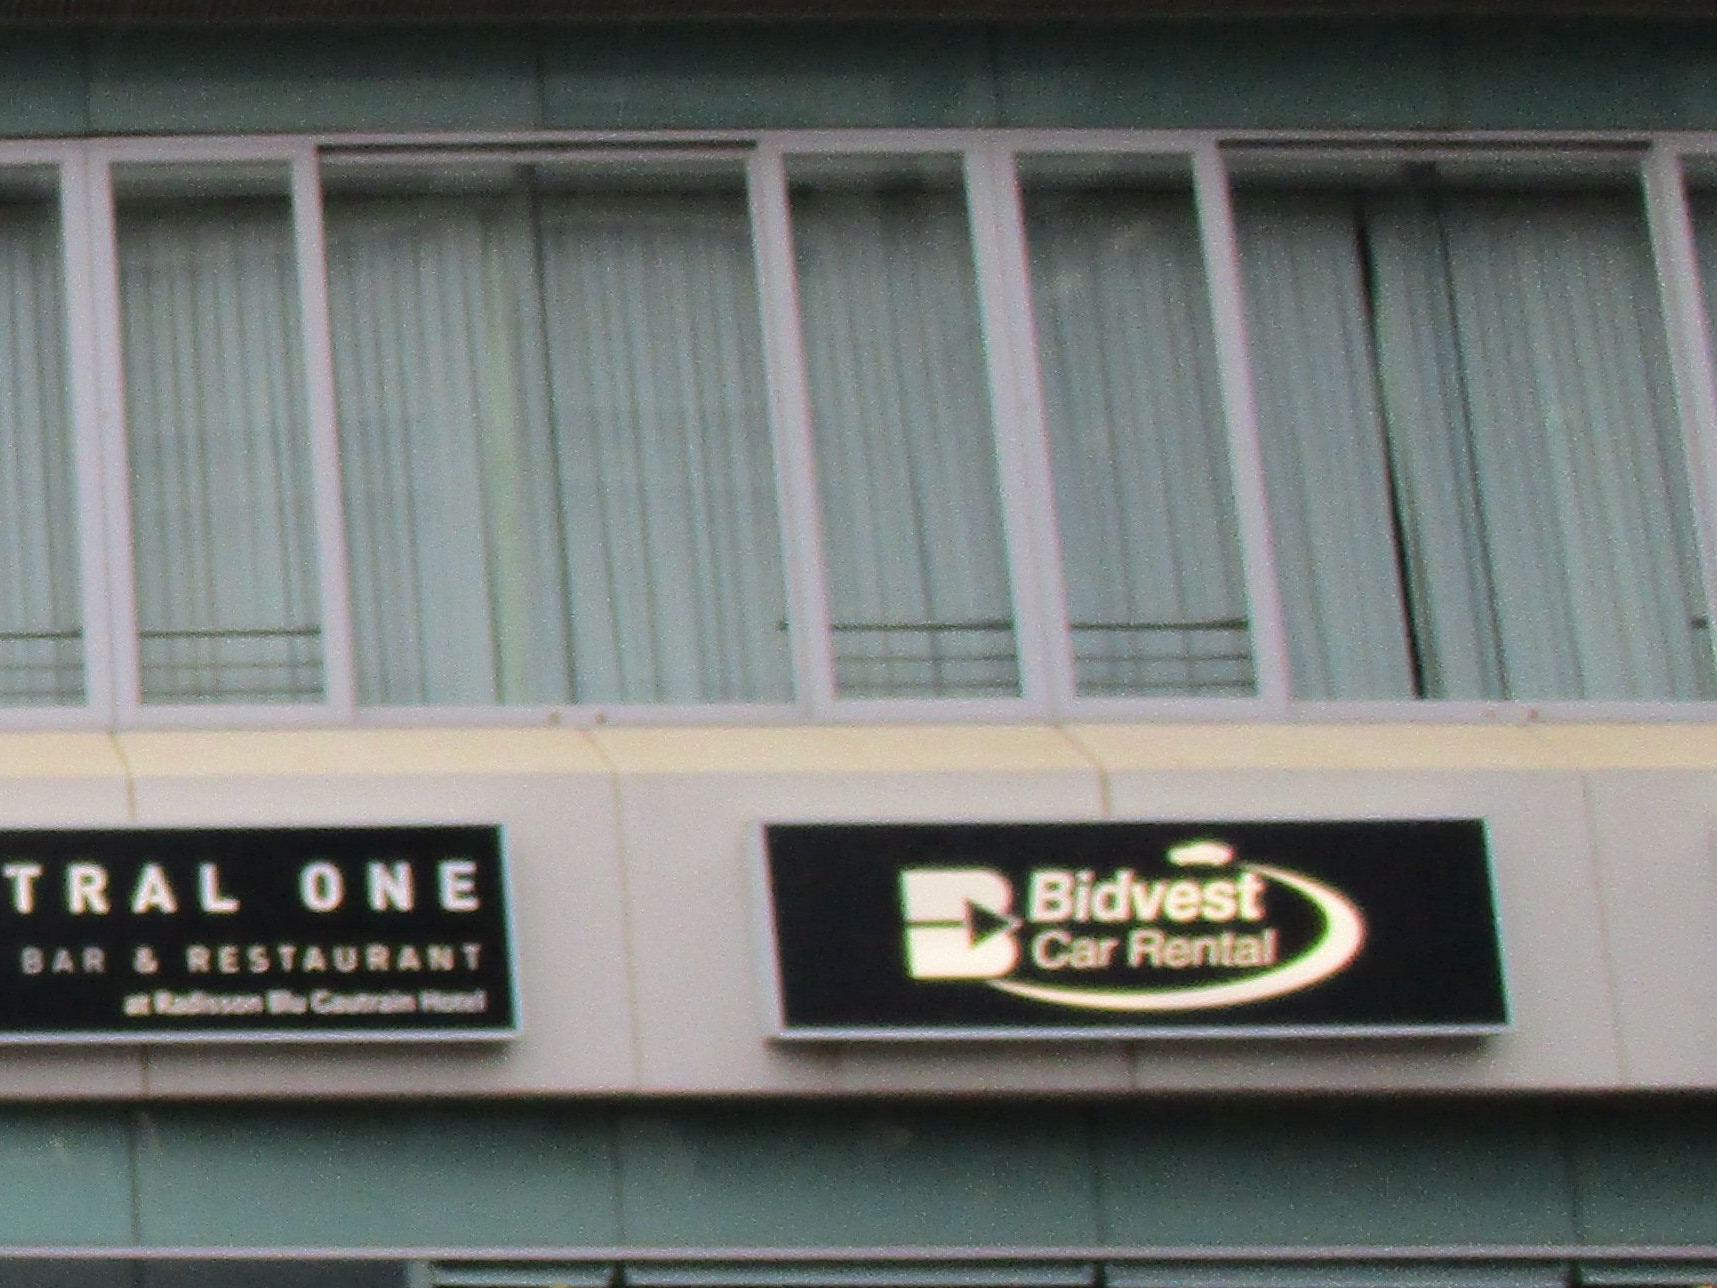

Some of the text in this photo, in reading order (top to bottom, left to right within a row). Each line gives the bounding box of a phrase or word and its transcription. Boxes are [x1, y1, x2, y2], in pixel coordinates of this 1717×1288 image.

[299, 859, 483, 913] ONE
[1026, 867, 1268, 925] Bidvest
[20, 942, 484, 975] BAR & RESTAURANT
[1030, 927, 1280, 971] Car Rental
